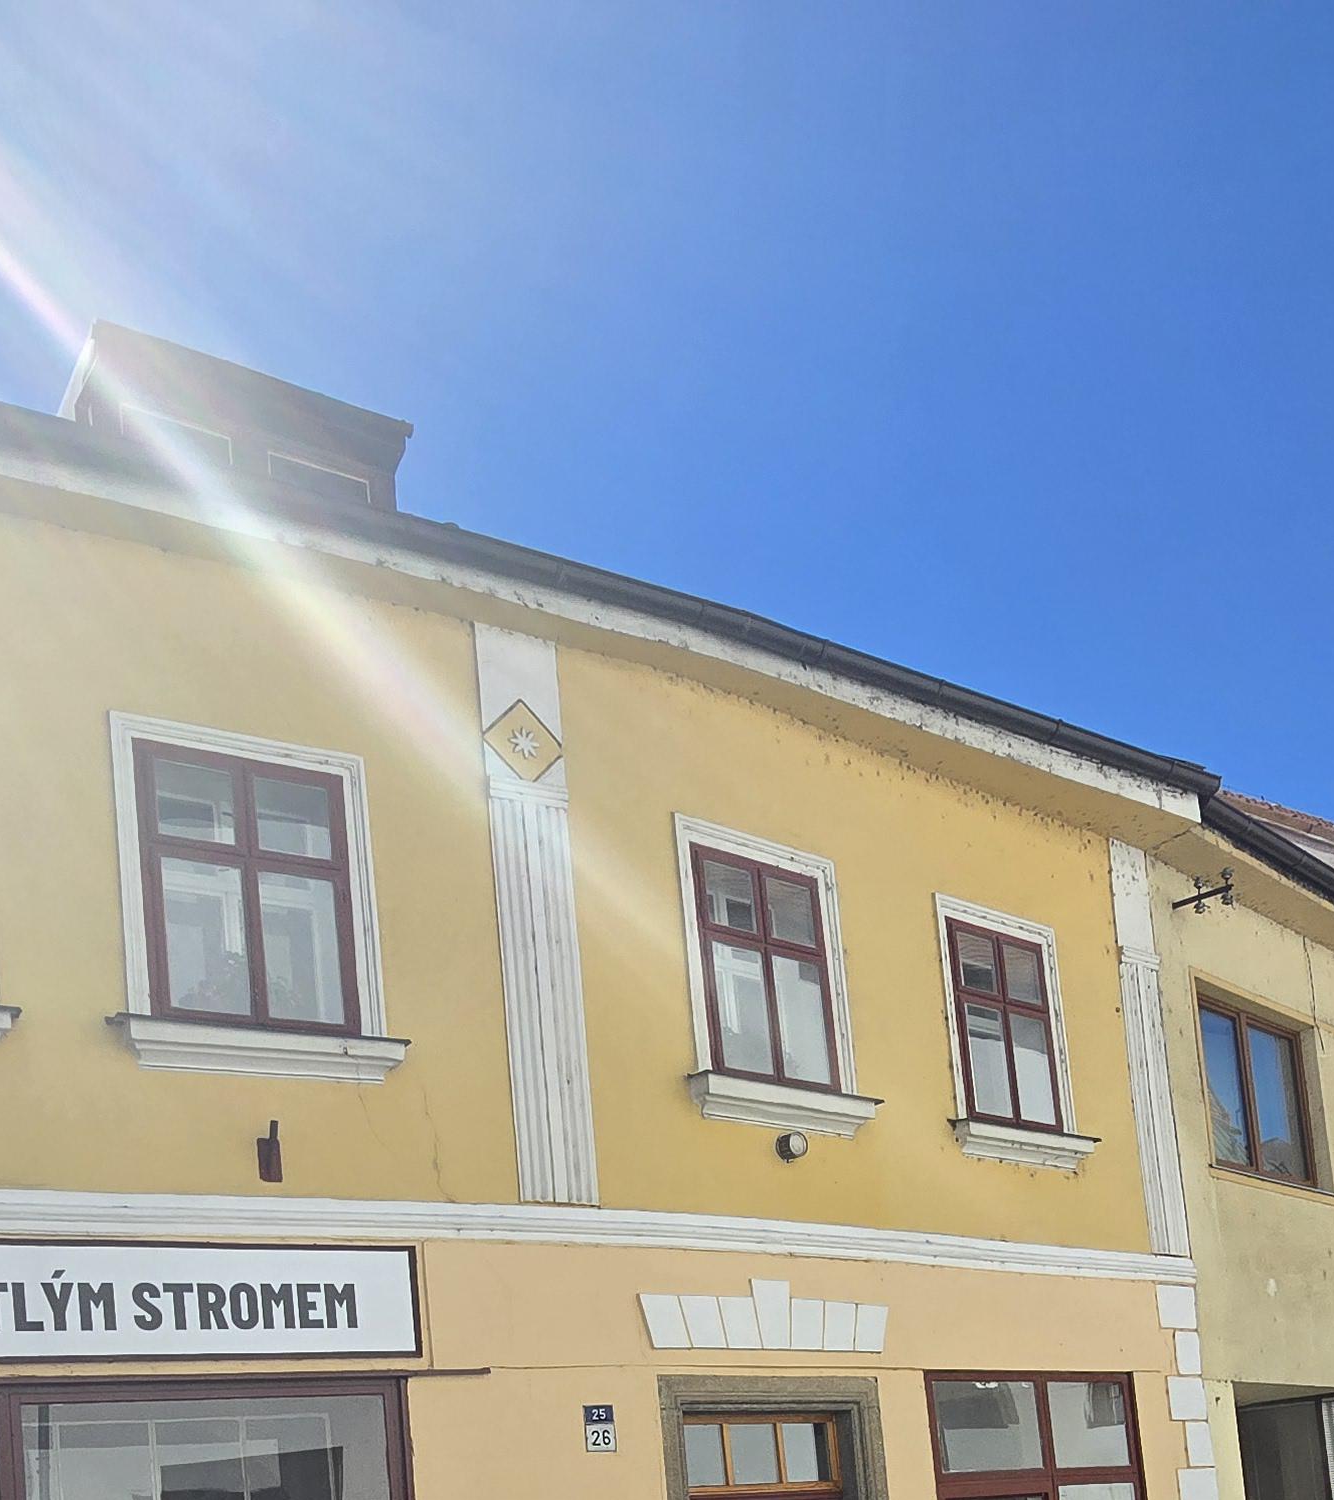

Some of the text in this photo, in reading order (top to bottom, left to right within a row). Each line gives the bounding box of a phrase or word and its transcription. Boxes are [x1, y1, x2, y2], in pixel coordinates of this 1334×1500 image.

[131, 1282, 359, 1331] STROMEM
[591, 1408, 607, 1420] 25
[591, 1429, 612, 1447] 26
